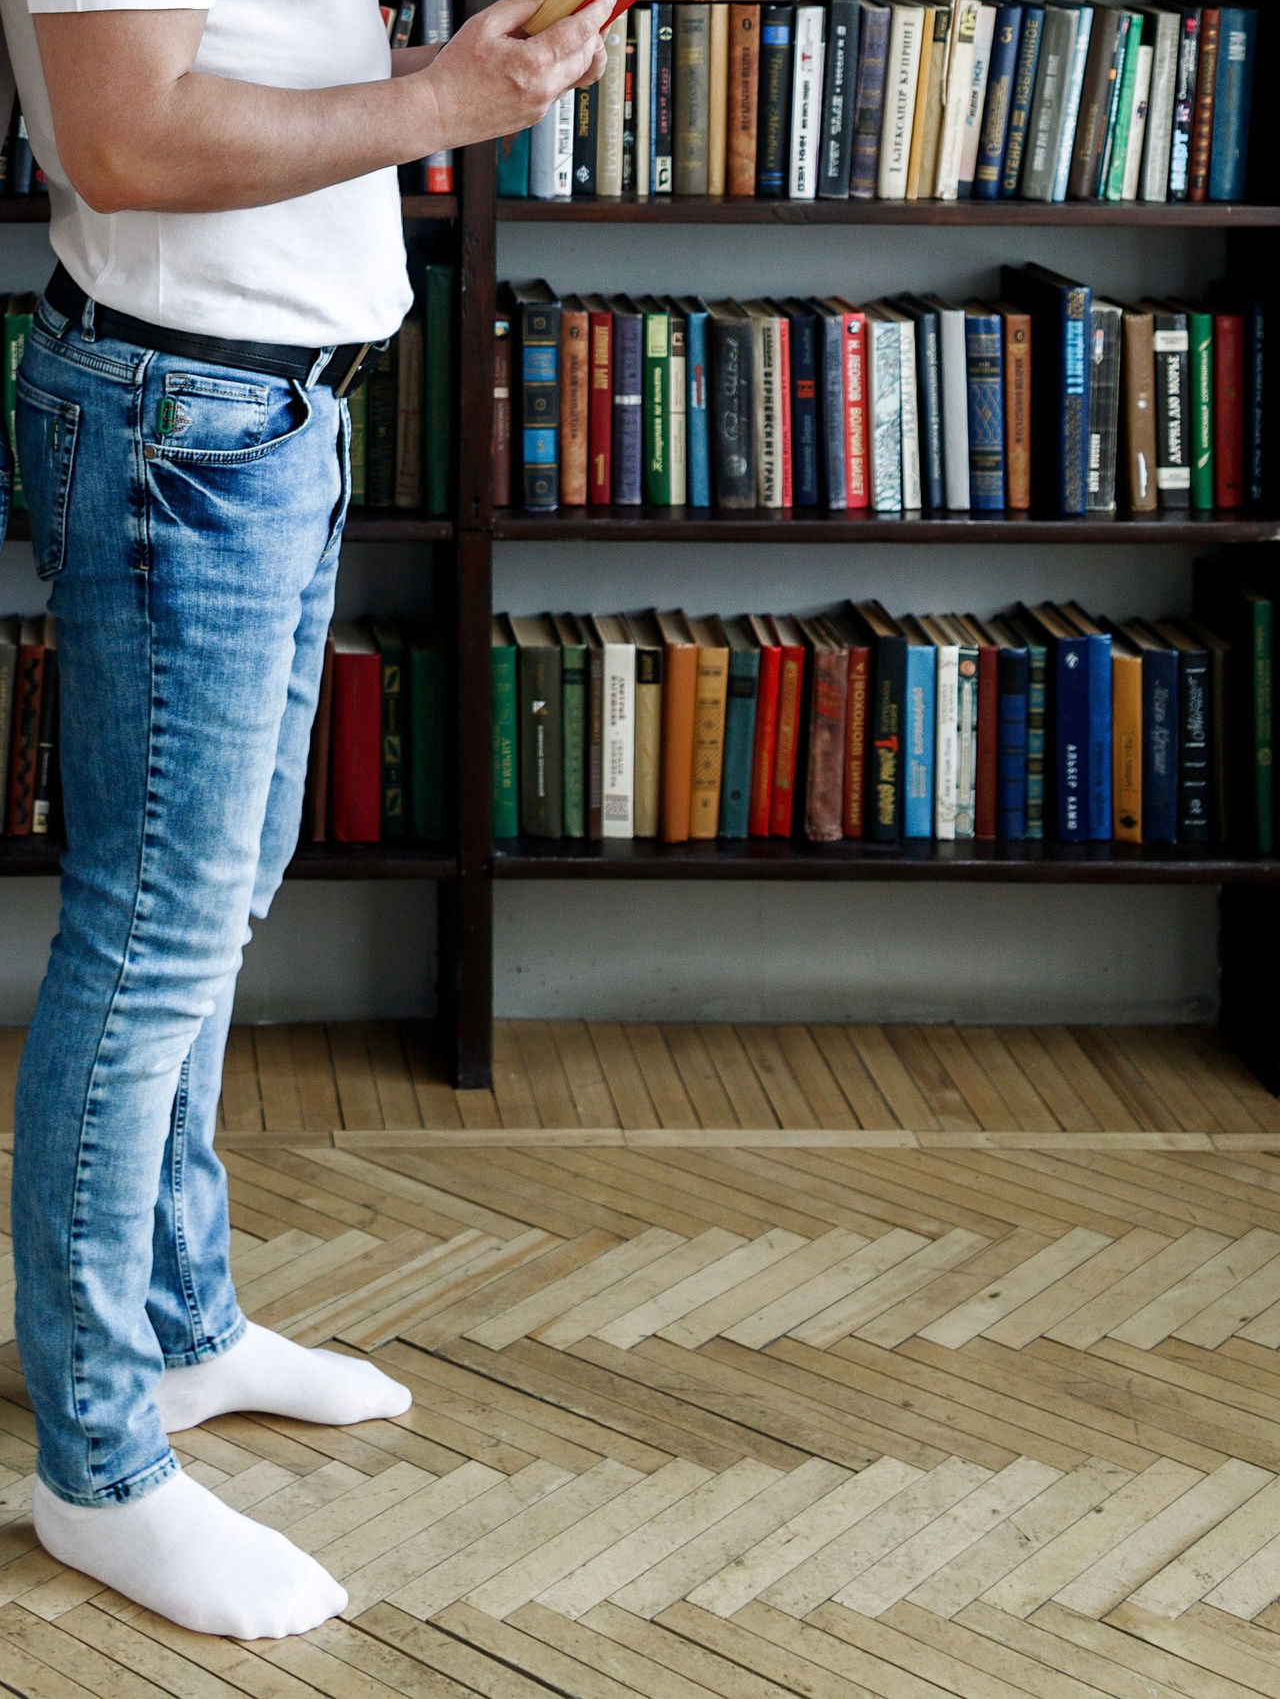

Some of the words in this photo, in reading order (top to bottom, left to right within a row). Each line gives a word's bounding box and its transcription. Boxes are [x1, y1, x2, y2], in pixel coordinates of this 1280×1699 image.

[897, 30, 914, 85] КУПРИН
[1014, 18, 1039, 105] ИЗБРАННОЕ
[579, 93, 591, 137] ЭНДРЮ
[892, 89, 909, 163] АЛЕКСАНДР
[848, 353, 862, 402] ЛЕОНОВ
[1166, 355, 1180, 395] МОРЬЕ
[763, 371, 775, 457] ВЕРНЕЙСКИЕ
[849, 406, 864, 455] ВОЛЧИЙ
[902, 393, 915, 440] ЛИЦОМ
[1167, 397, 1181, 419] ДЮ
[1168, 420, 1182, 465] ДАФНА
[764, 460, 775, 502] ГРАЧИ
[850, 456, 864, 496] БИЛЕТ
